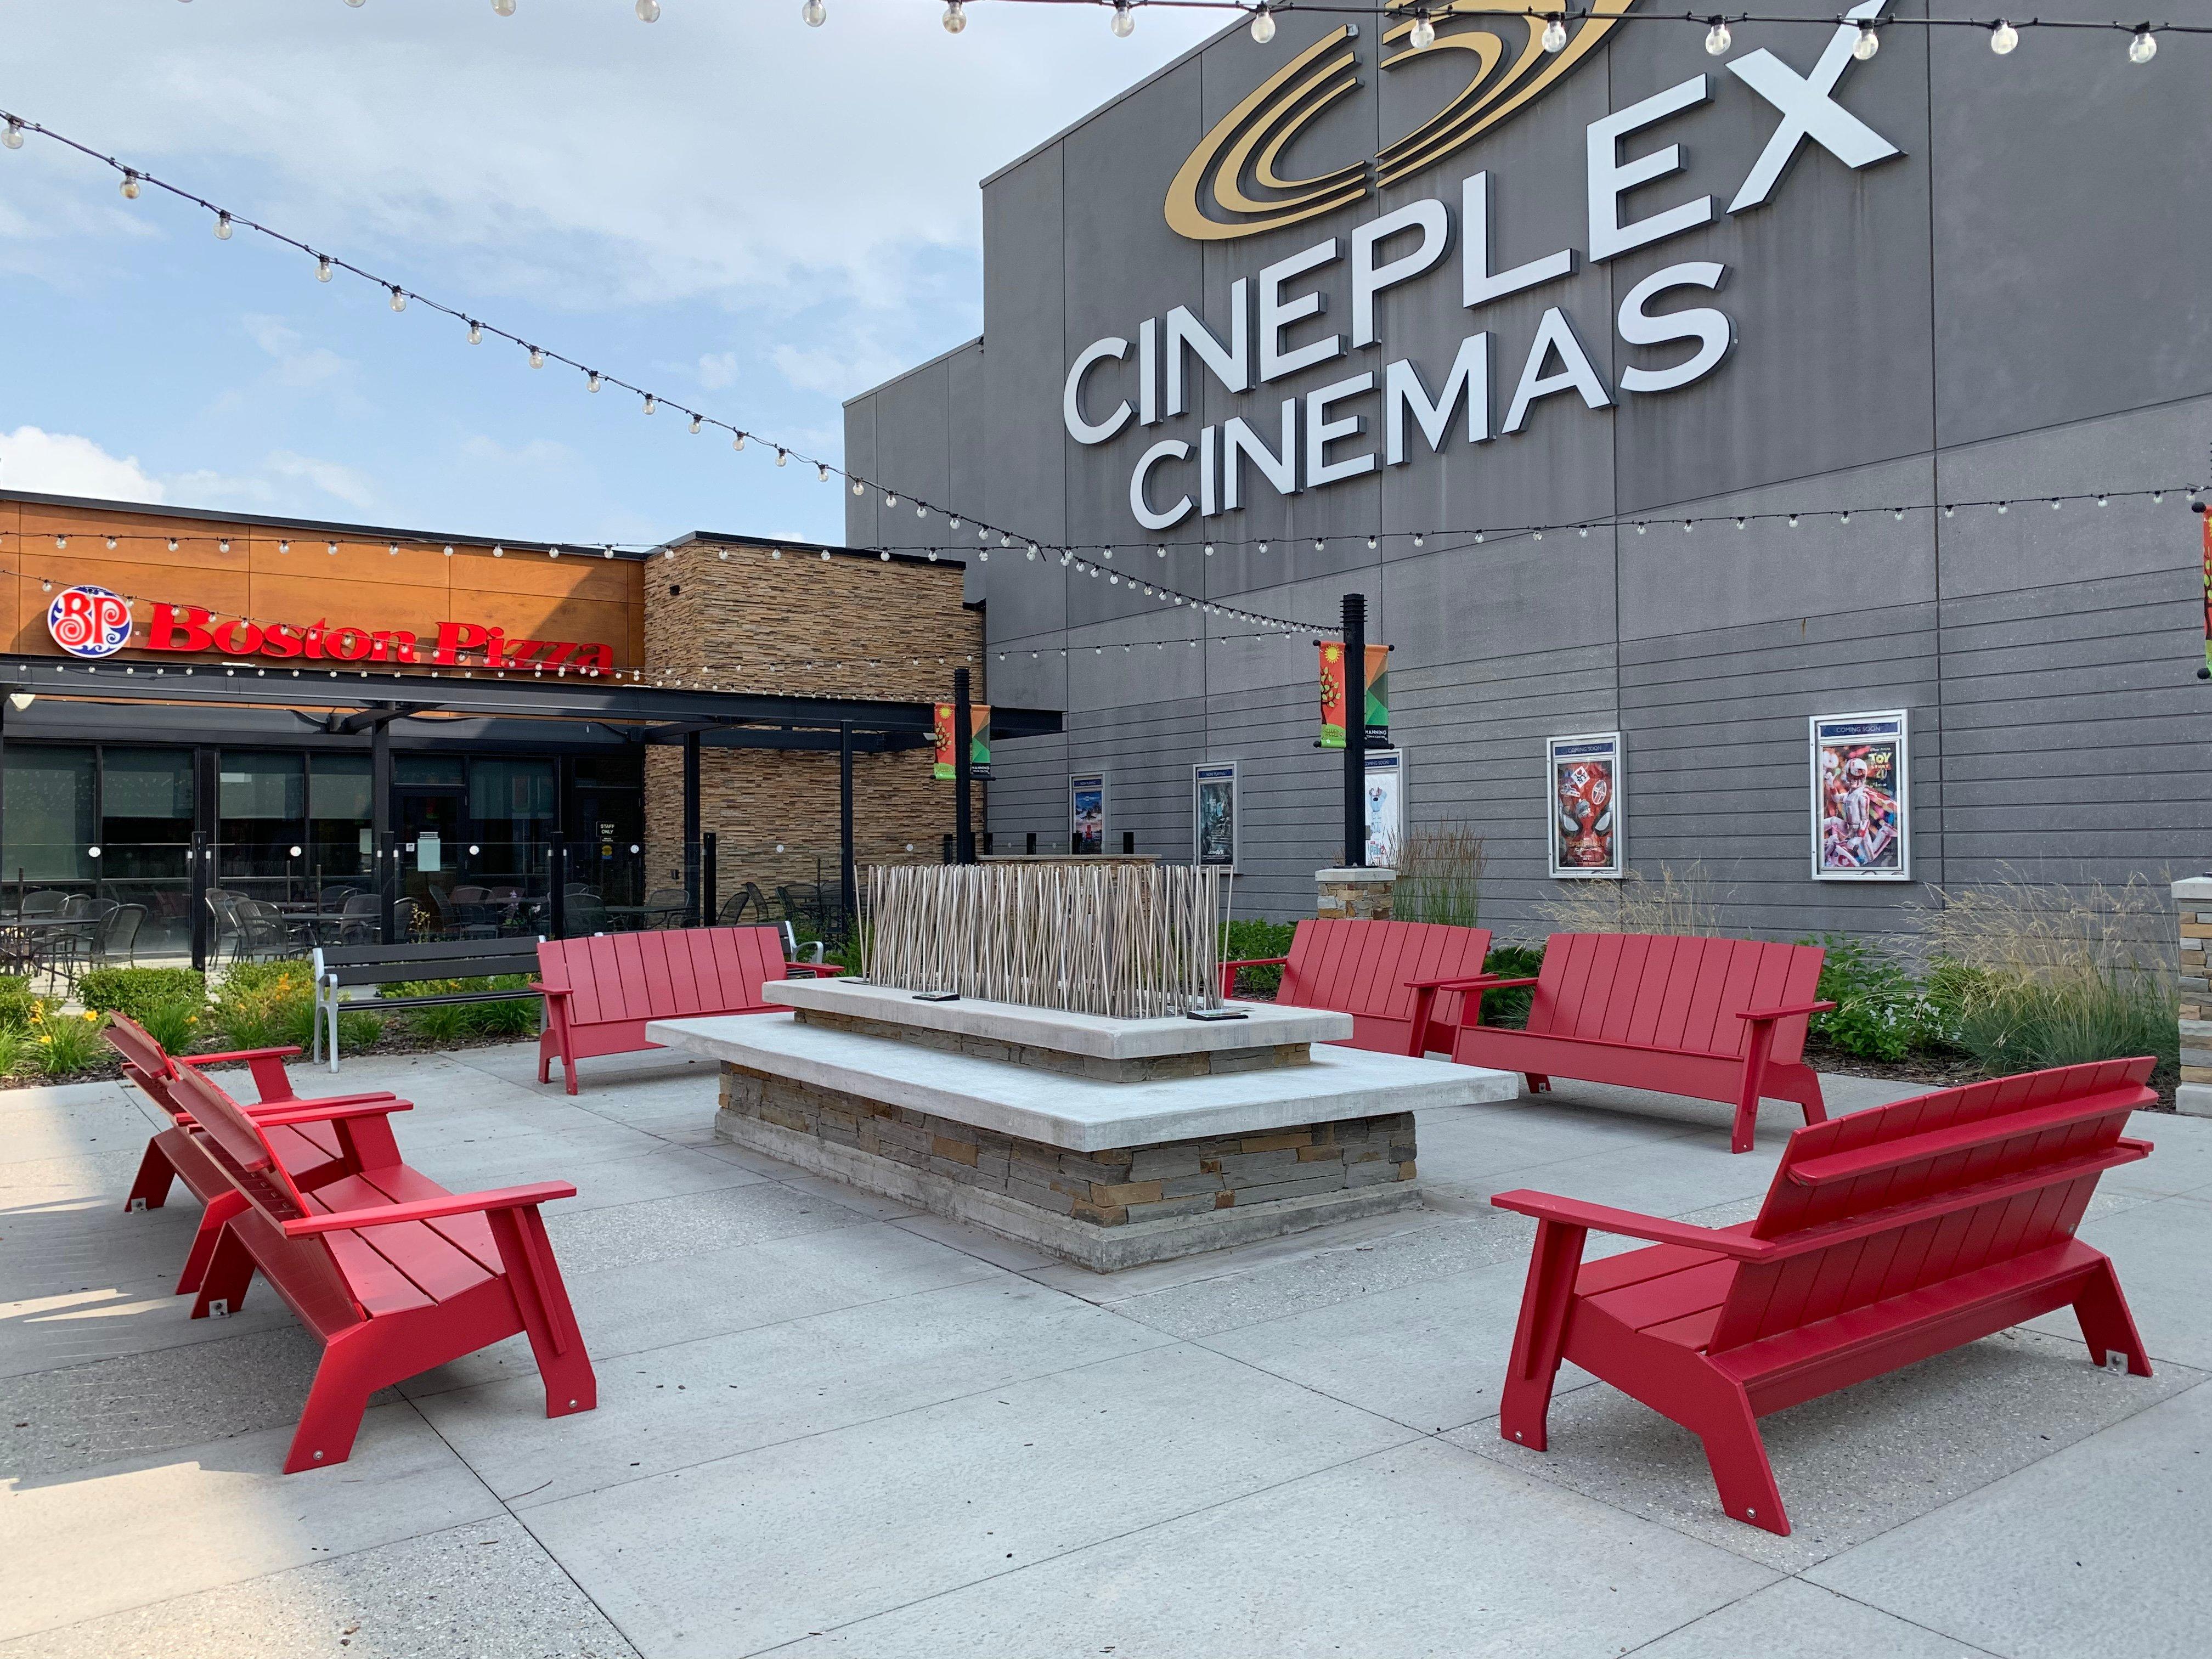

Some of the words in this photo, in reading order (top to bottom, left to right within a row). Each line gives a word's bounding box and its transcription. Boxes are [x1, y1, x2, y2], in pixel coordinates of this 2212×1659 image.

[1063, 0, 1908, 445] CINEPLEX
[1129, 261, 1738, 531] CINEMAS
[144, 602, 417, 663] Boston
[433, 622, 614, 675] Pizza
[1868, 752, 1892, 764] TOY
